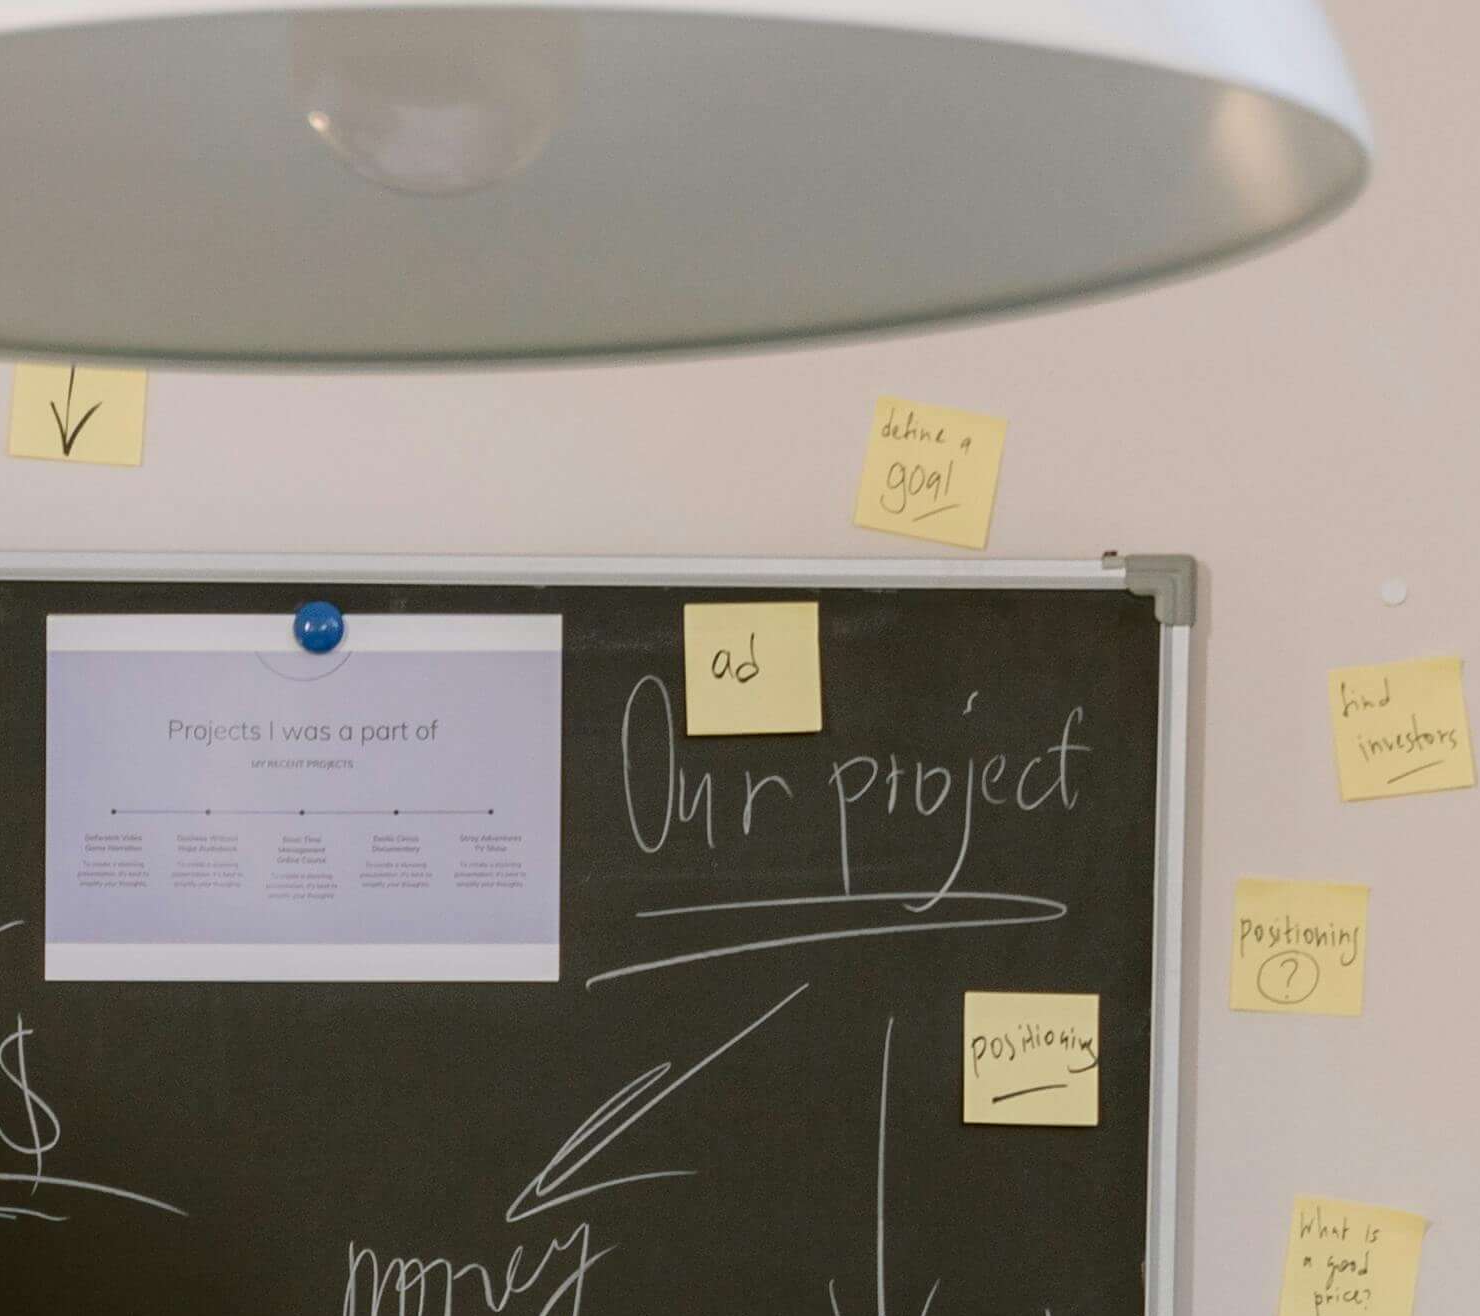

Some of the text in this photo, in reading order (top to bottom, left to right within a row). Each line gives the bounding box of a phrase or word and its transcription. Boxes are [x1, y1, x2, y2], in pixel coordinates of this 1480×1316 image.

[880, 406, 946, 444] define
[879, 459, 955, 516] goal
[710, 632, 759, 683] ad
[1340, 675, 1391, 718] find
[168, 719, 440, 747] Projects I was a part of
[1357, 712, 1459, 763] investors
[621, 674, 1093, 913] Our project
[1239, 914, 1360, 967] positioning
[970, 1022, 1099, 1080] positioning
